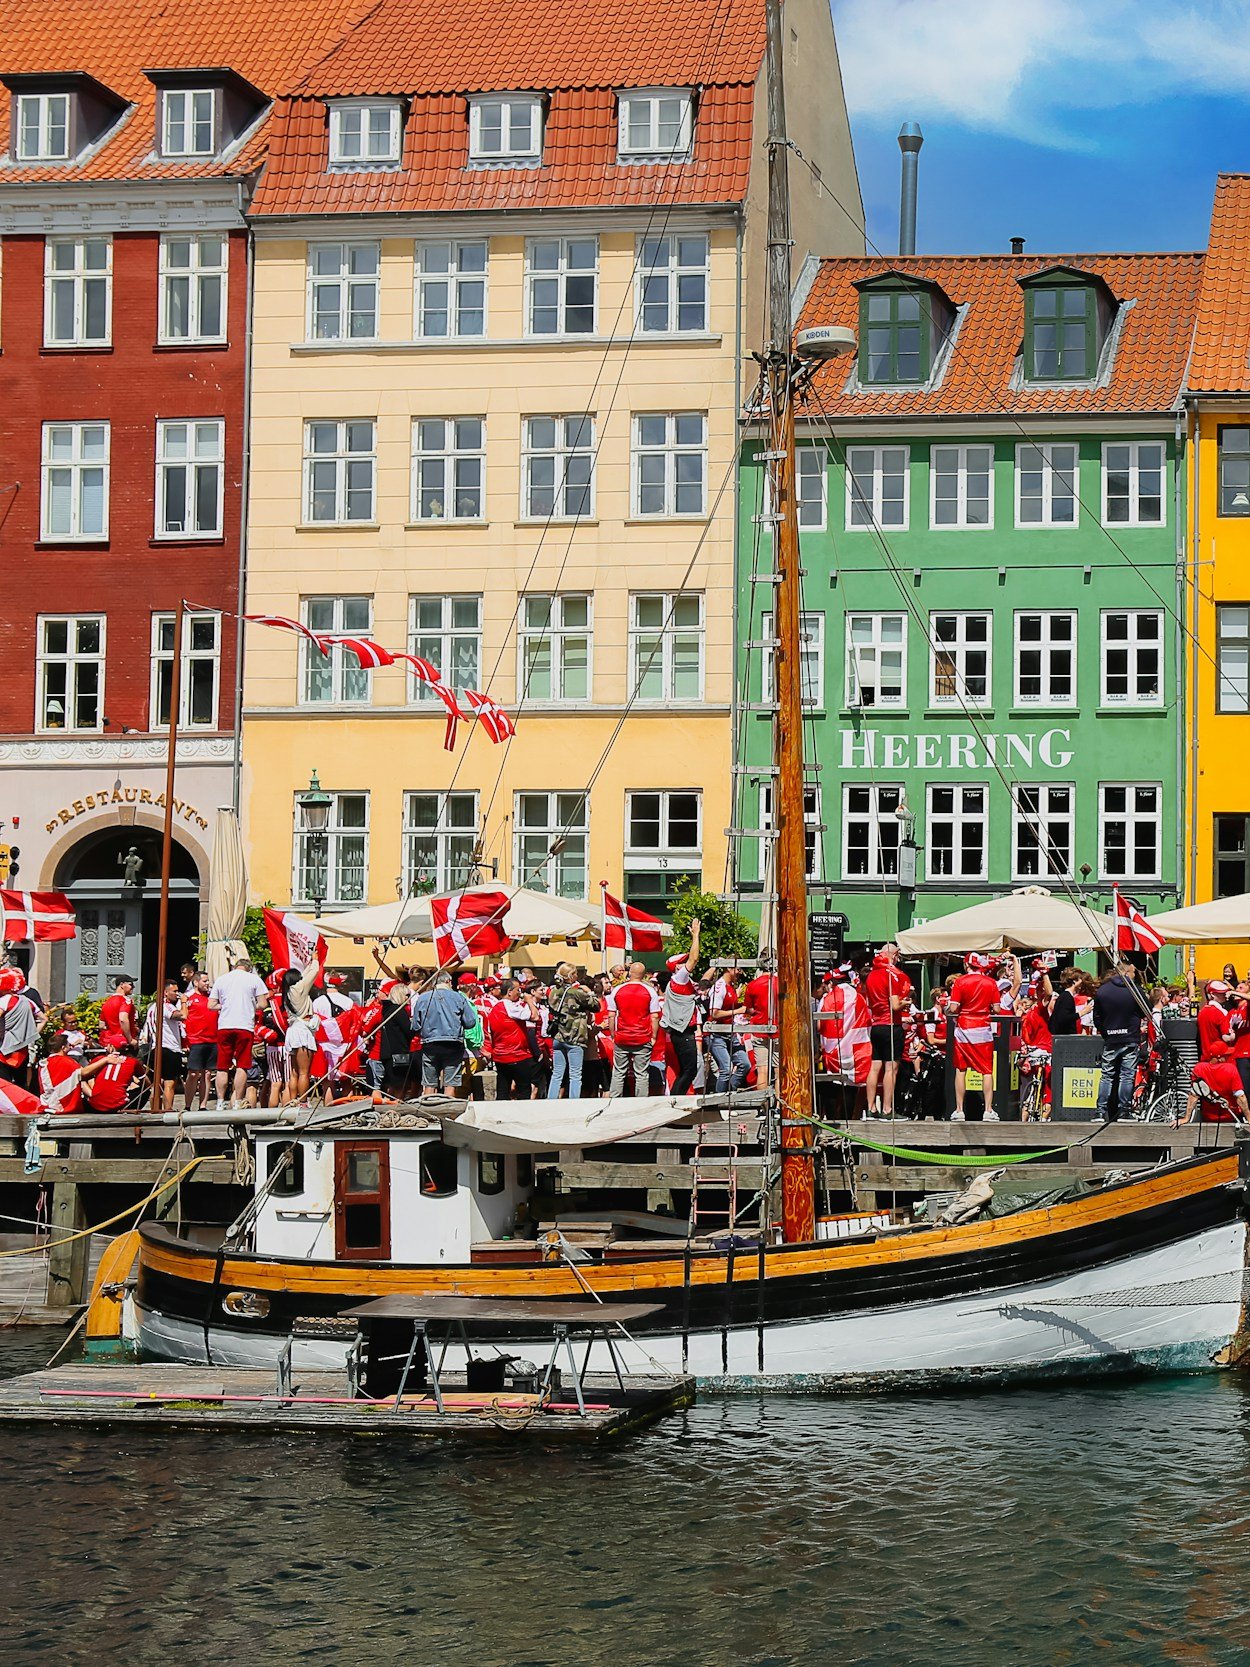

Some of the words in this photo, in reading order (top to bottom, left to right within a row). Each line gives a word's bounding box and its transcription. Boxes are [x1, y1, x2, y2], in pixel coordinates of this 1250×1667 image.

[806, 330, 830, 340] KODEN
[837, 728, 1075, 769] HEERING
[57, 788, 198, 826] RESTAURANT
[659, 857, 668, 868] 13
[104, 1062, 121, 1082] 11
[1071, 1079, 1093, 1088] REN
[1071, 1090, 1093, 1098] KBH
